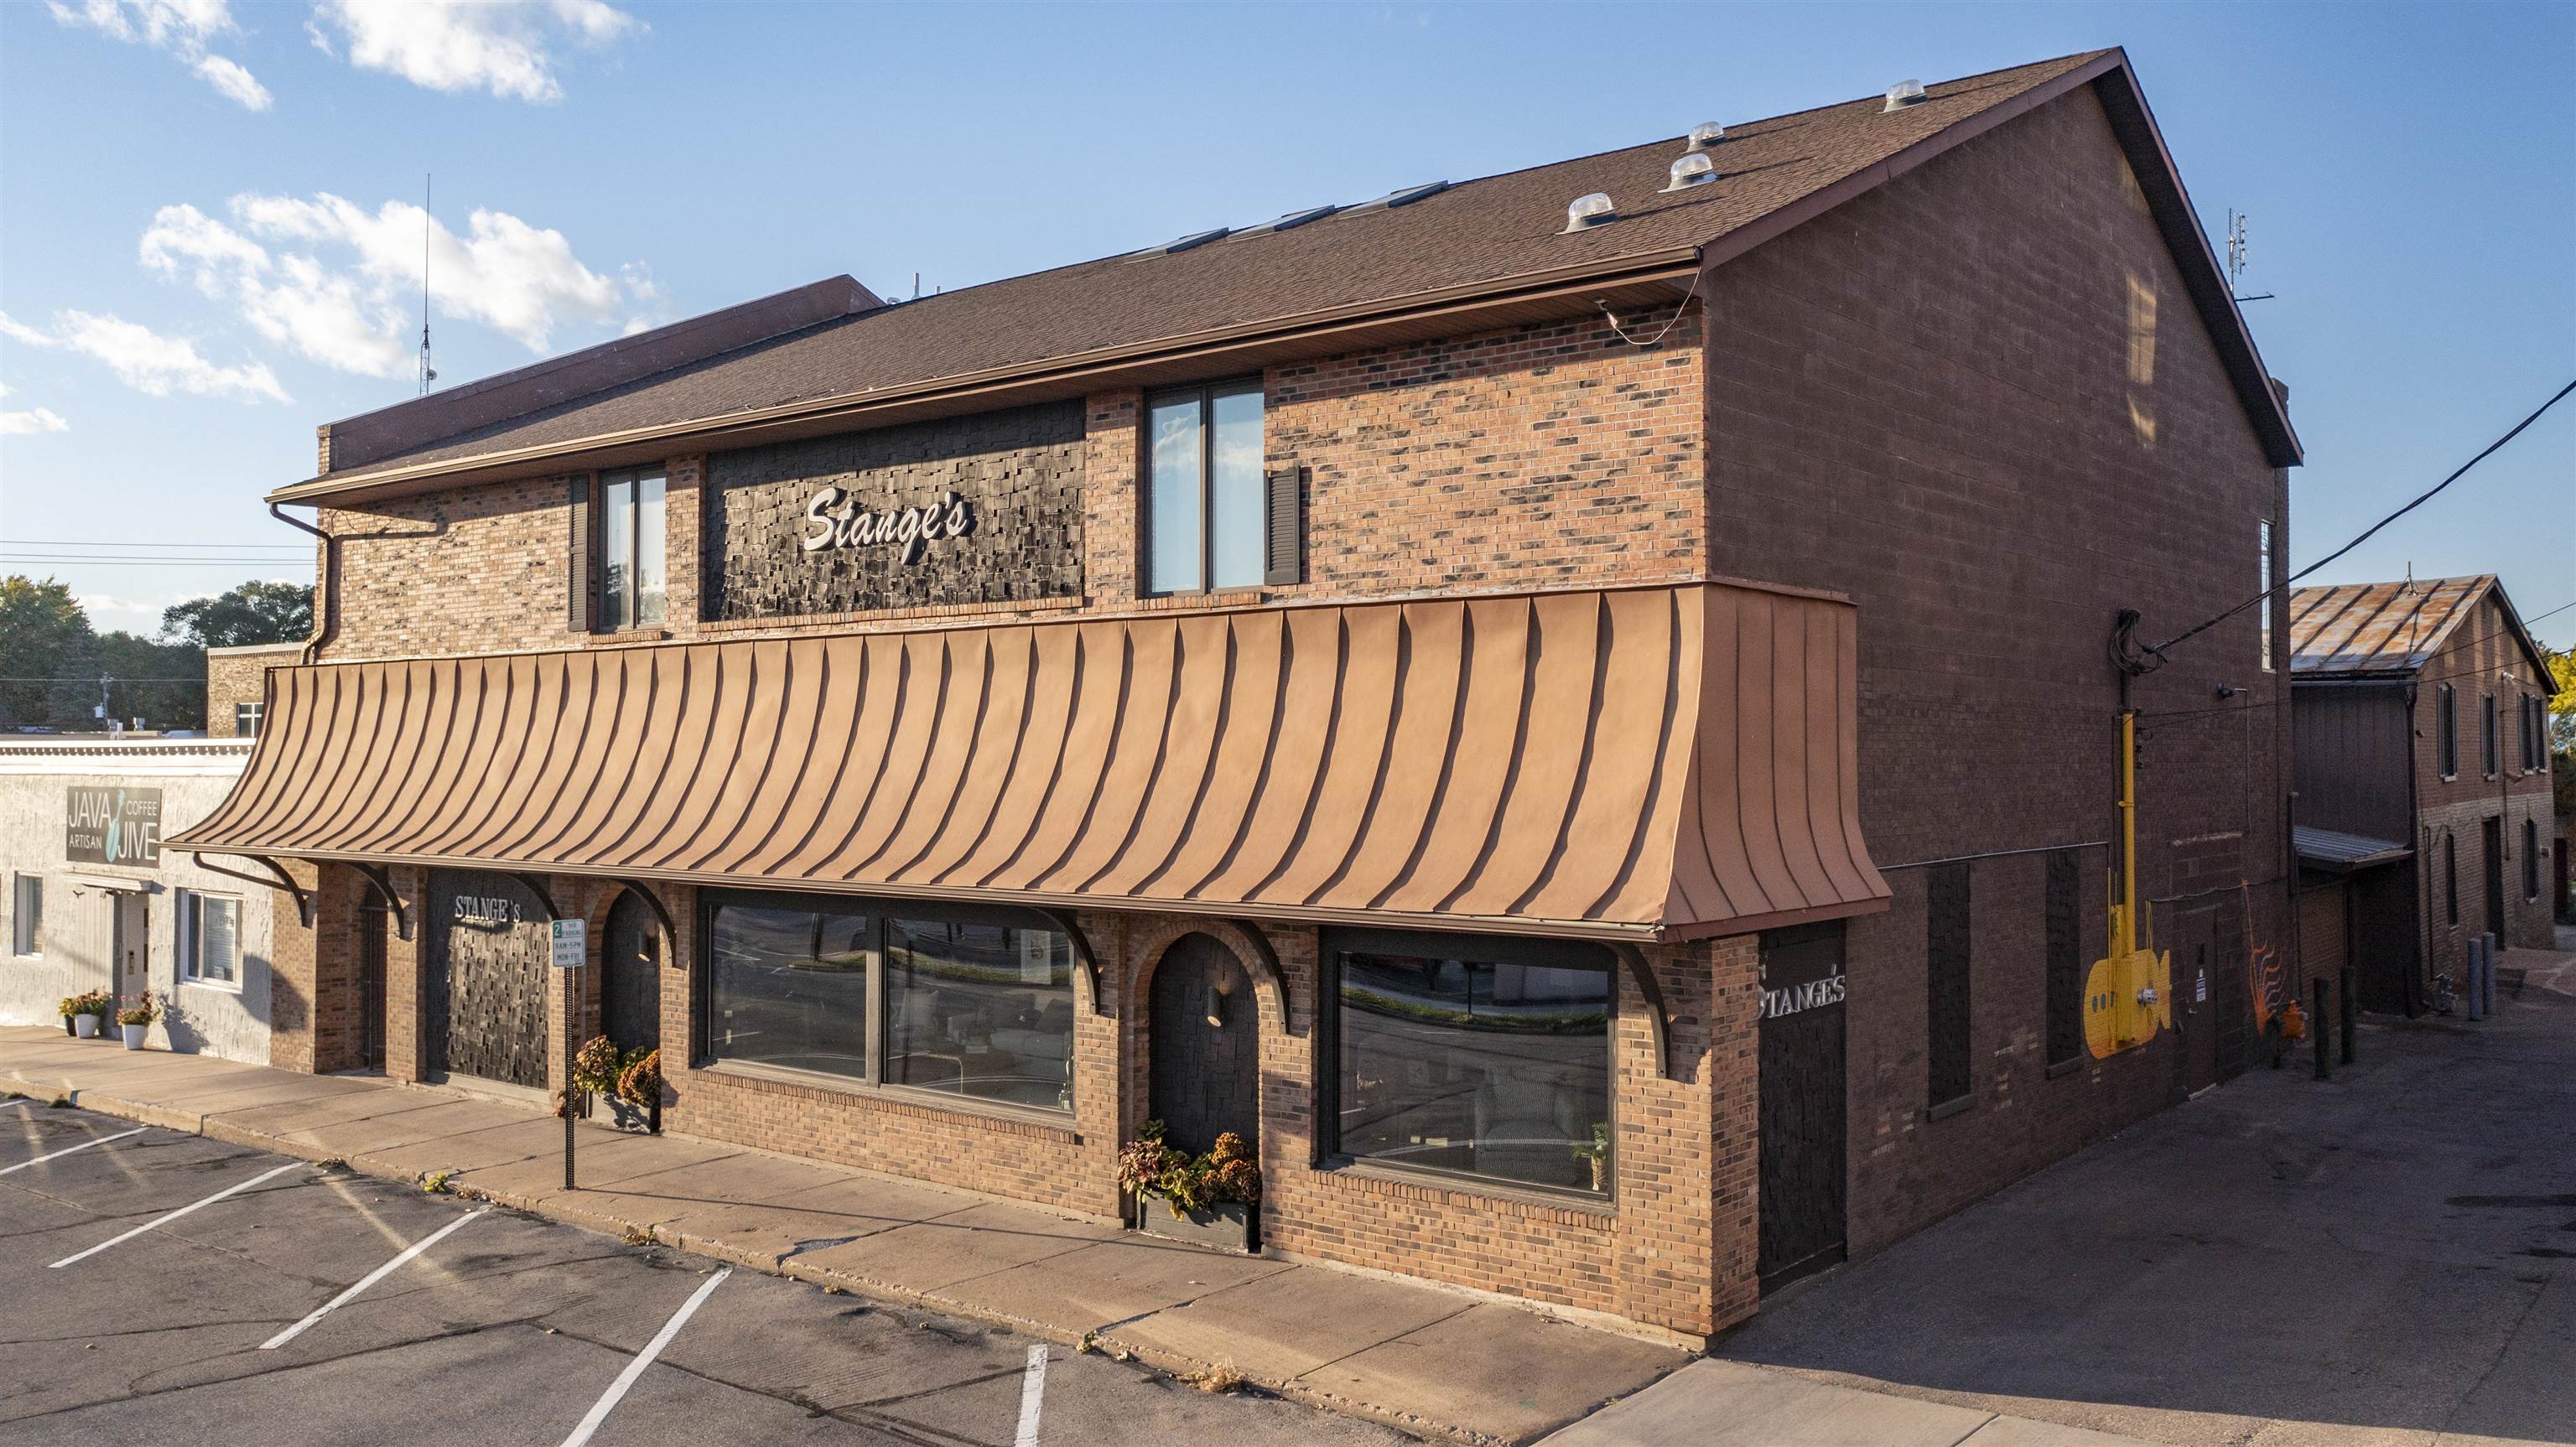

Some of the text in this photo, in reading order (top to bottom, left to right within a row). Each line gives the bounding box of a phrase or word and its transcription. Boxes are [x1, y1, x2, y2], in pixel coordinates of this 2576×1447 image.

[804, 487, 968, 565] Stange's
[69, 791, 112, 828] JAVA
[127, 800, 158, 816] COFFEE
[69, 834, 102, 849] ARTISAN
[117, 822, 158, 860] JIVE
[554, 924, 560, 936] 2
